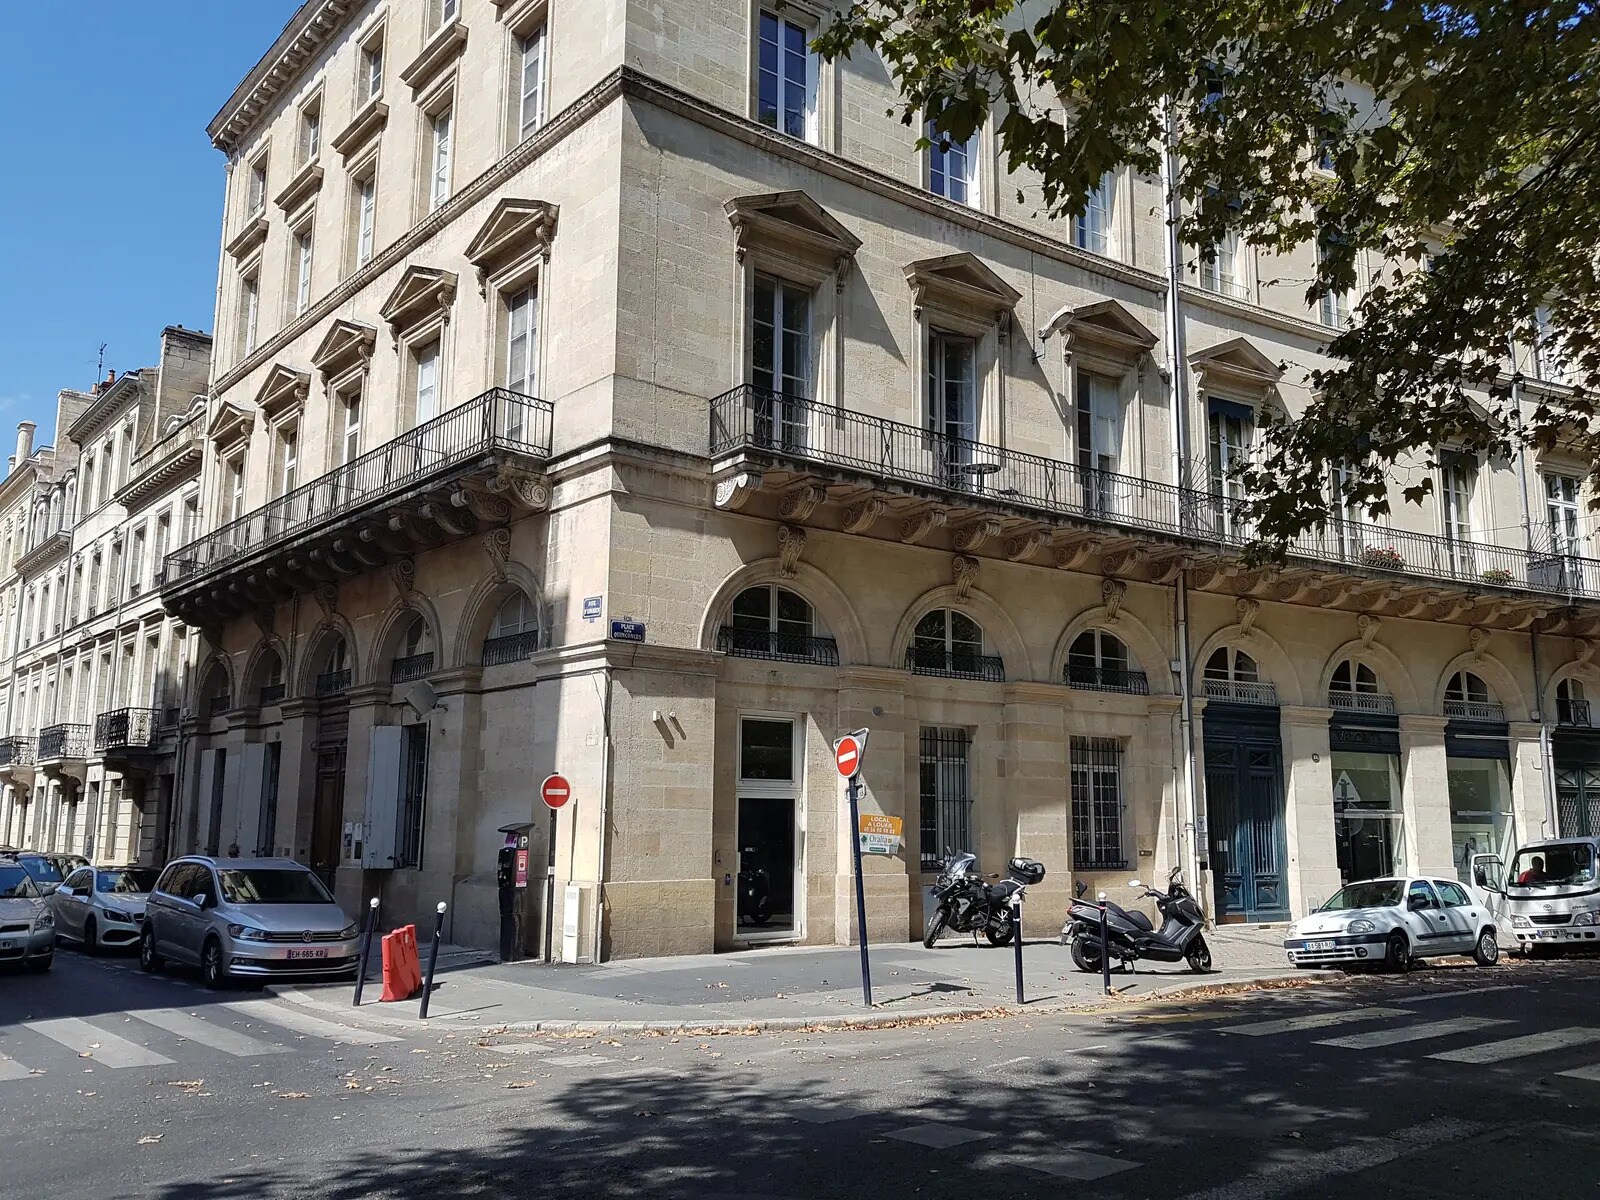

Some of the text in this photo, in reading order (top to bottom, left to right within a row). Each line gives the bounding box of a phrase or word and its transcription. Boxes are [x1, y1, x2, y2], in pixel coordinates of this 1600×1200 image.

[620, 623, 635, 631] PLACE
[614, 631, 642, 640] QUINCONCES
[873, 821, 893, 829] LOUER
[521, 836, 528, 848] P
[869, 835, 888, 843] Oralia
